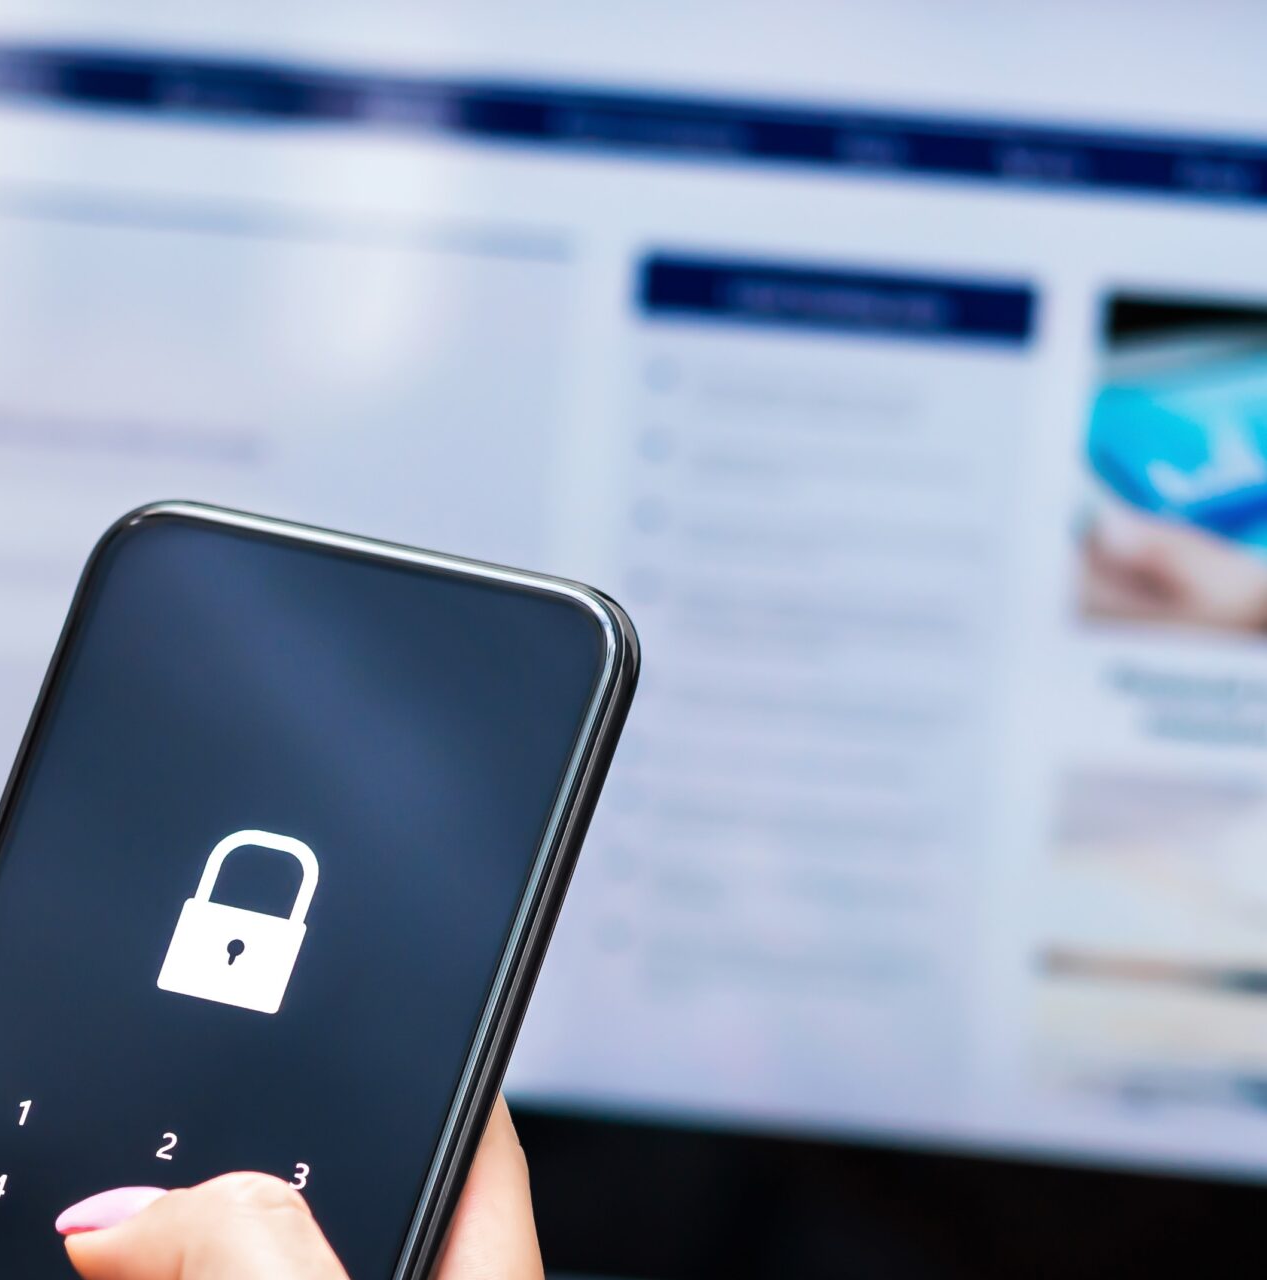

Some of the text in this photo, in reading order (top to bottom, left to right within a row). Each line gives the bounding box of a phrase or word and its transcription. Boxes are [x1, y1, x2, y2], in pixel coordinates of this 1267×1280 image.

[18, 1100, 310, 1190] 1 2 3
